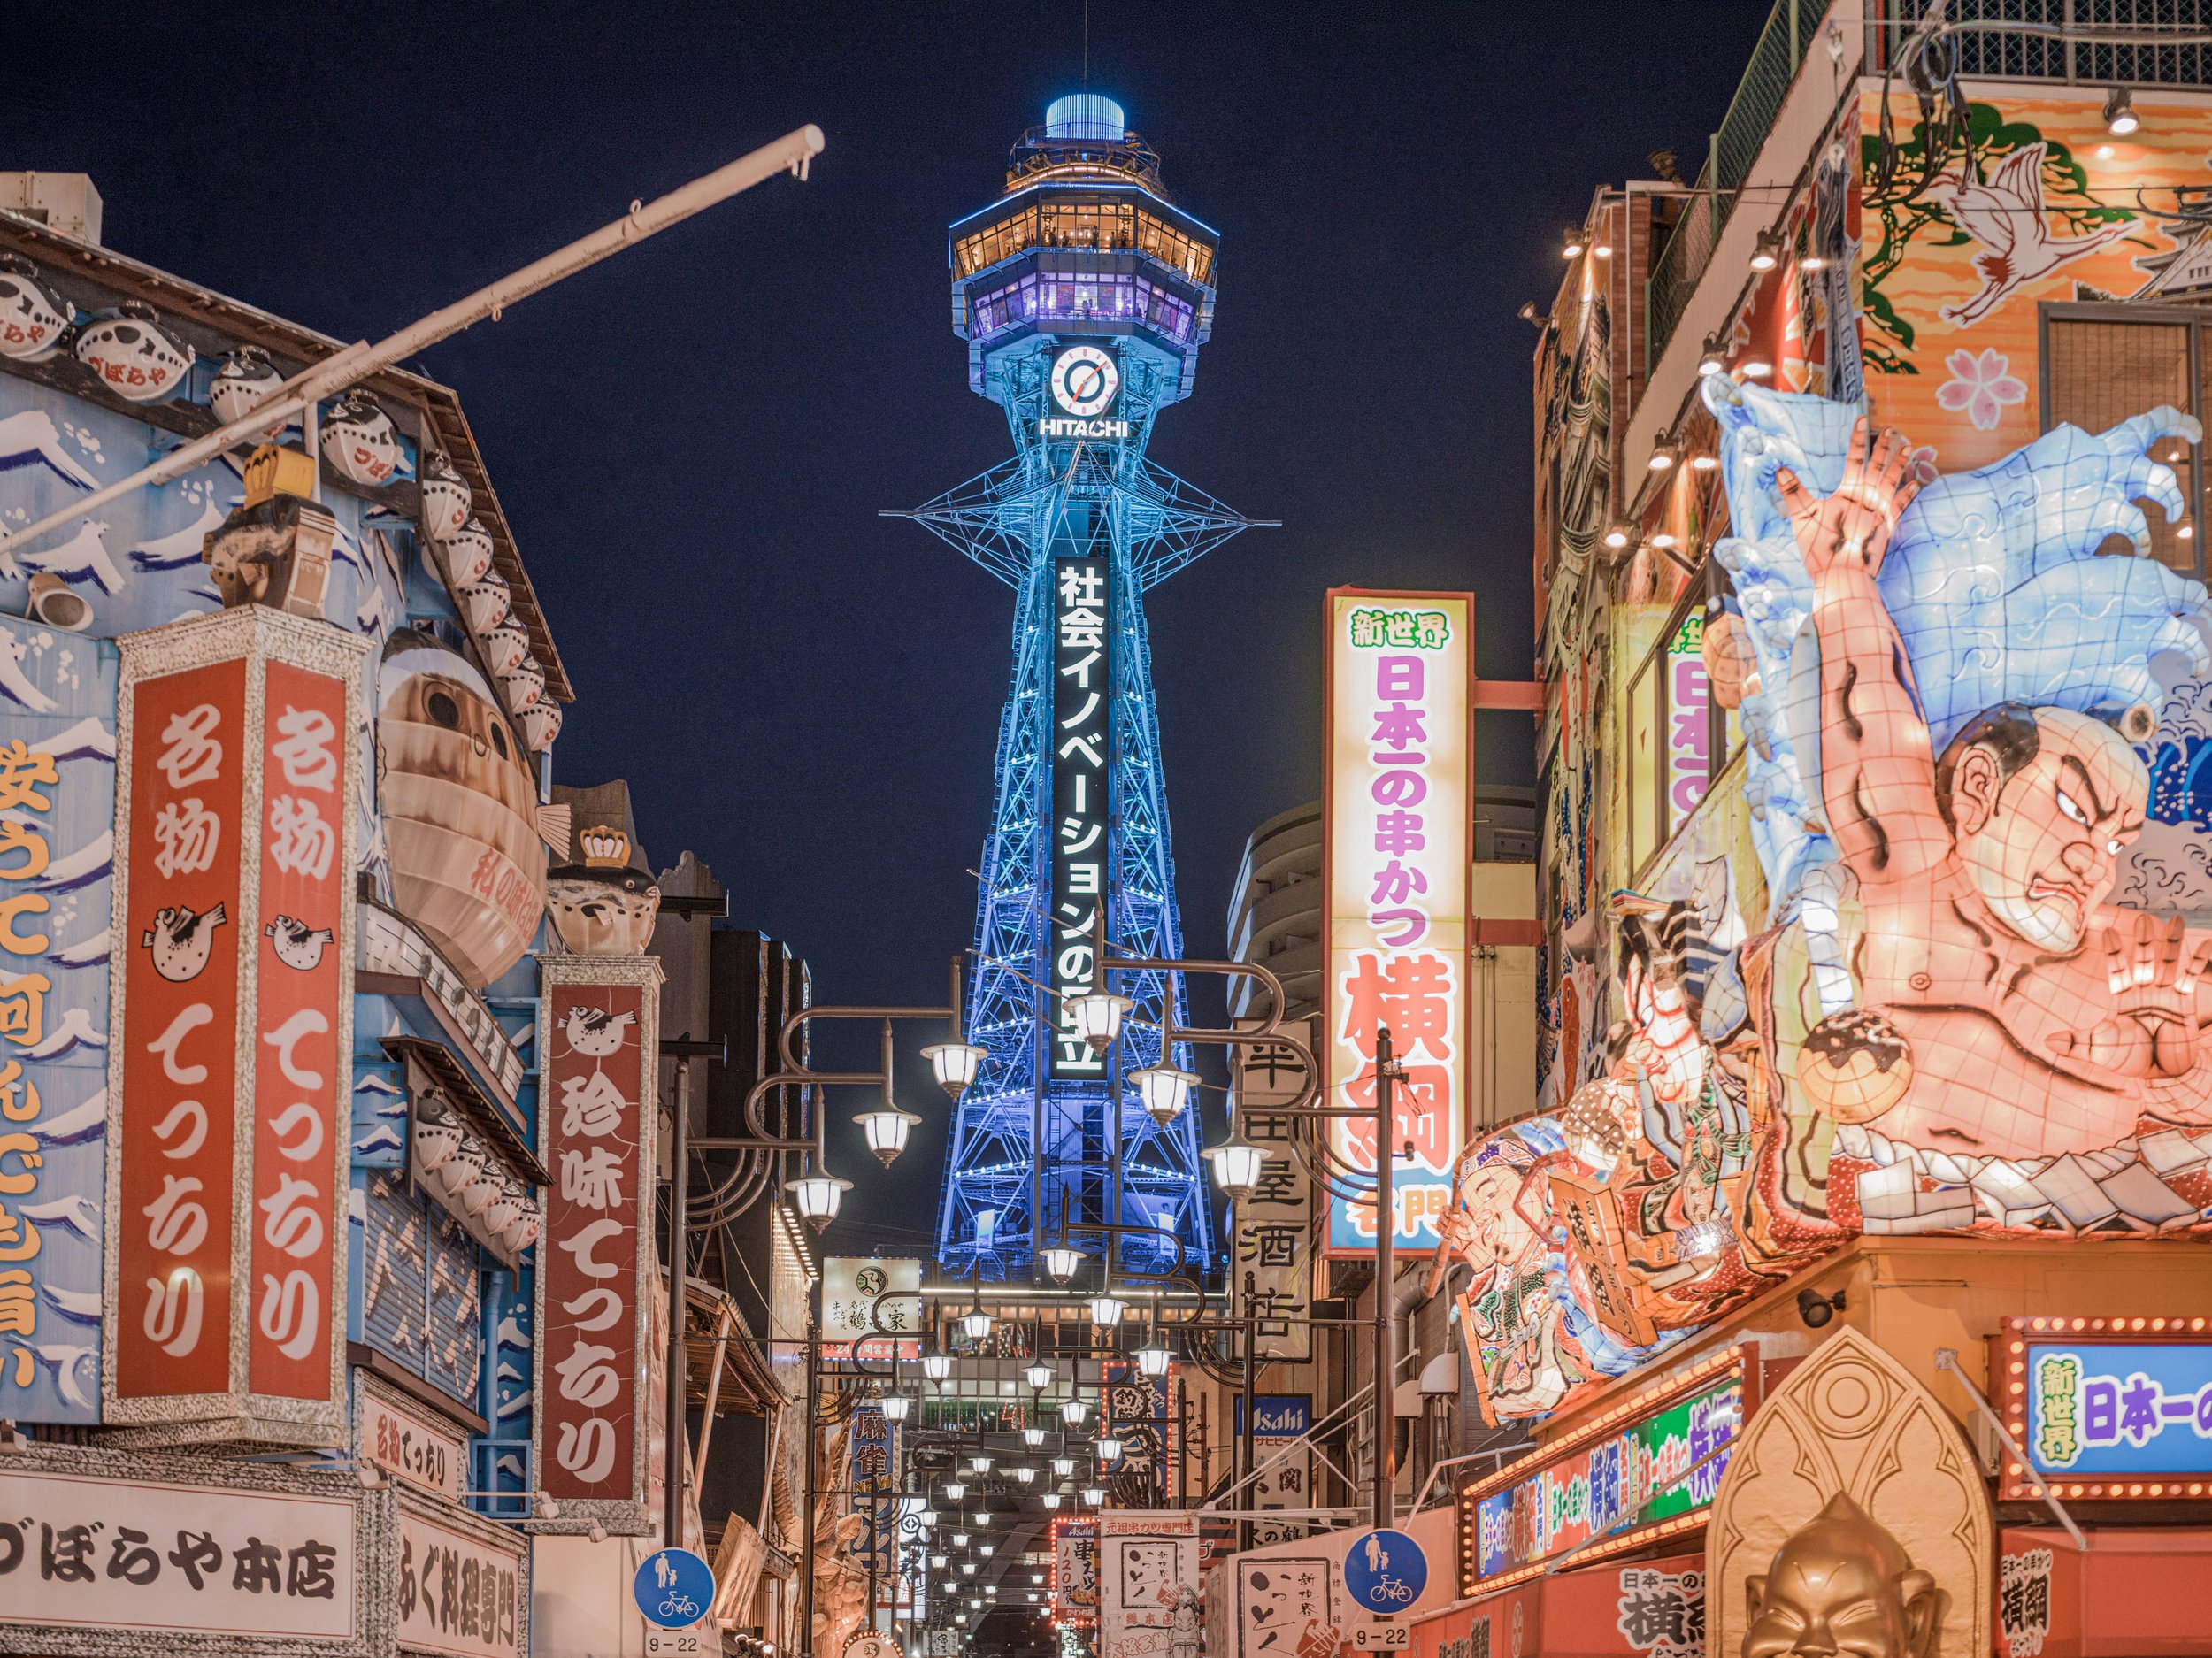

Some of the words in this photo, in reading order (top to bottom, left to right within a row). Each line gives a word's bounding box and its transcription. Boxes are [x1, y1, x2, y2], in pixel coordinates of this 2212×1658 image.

[1040, 419, 1128, 437] HITACHI
[1350, 610, 1448, 649] 新世界
[155, 703, 223, 879] 名物
[271, 704, 338, 880] 名物
[1370, 656, 1429, 947] 日本一の串かつ
[1343, 953, 1451, 1170] 横綱
[142, 1002, 214, 1357] てっちり
[258, 1009, 329, 1360] てっちり
[554, 1071, 626, 1484] 珍味てっちり
[377, 1413, 445, 1496] 名物てっちり
[854, 1409, 888, 1475] 麻雀
[1253, 1436, 1301, 1447] サヒビール
[2040, 1359, 2078, 1462] 新世界
[0, 1517, 337, 1599] づぼらや本店
[1106, 1521, 1194, 1535] 元祖串カツ専門店
[400, 1535, 514, 1647] ふぐ料理専門
[1298, 1572, 1319, 1618] 新世界
[2002, 1574, 2049, 1635] 横綱
